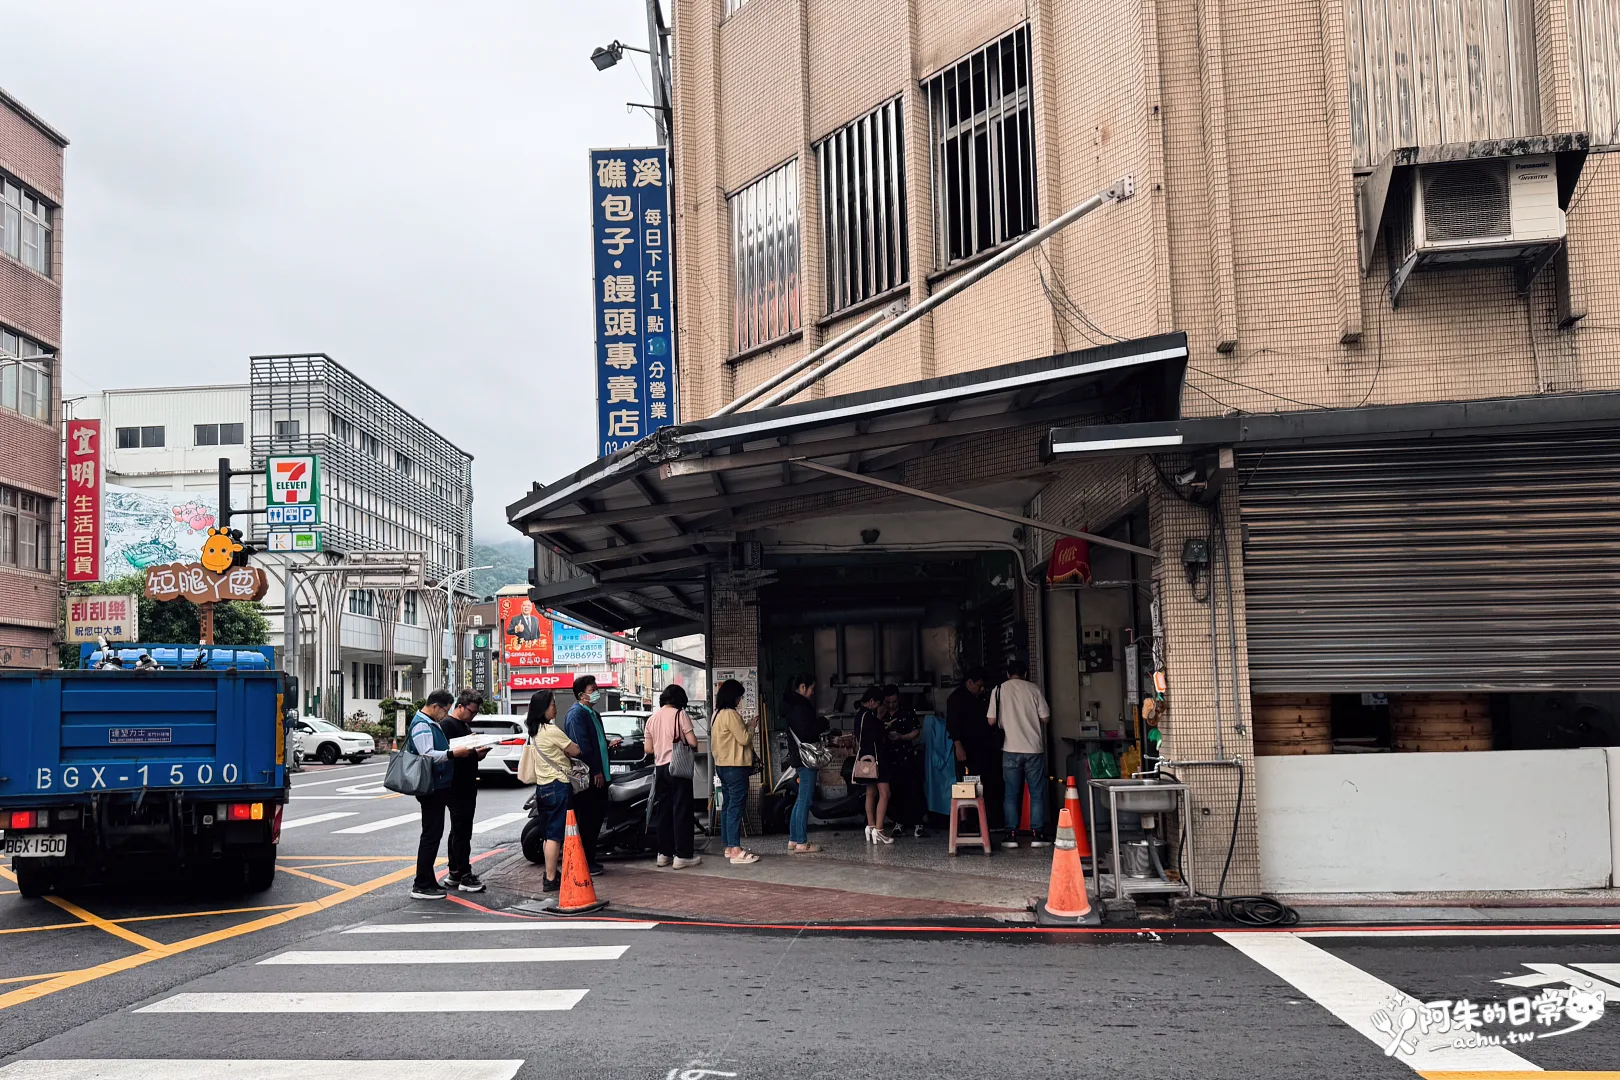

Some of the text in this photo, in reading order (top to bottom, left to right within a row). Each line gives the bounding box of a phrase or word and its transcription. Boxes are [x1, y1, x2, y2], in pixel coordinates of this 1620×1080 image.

[597, 158, 663, 188] 礁溪
[1515, 161, 1550, 169] Panasonic
[303, 509, 312, 520] P
[148, 568, 254, 599] 短腿丫鹿
[72, 600, 126, 621] 刮刮樂
[513, 676, 560, 686] SHARP
